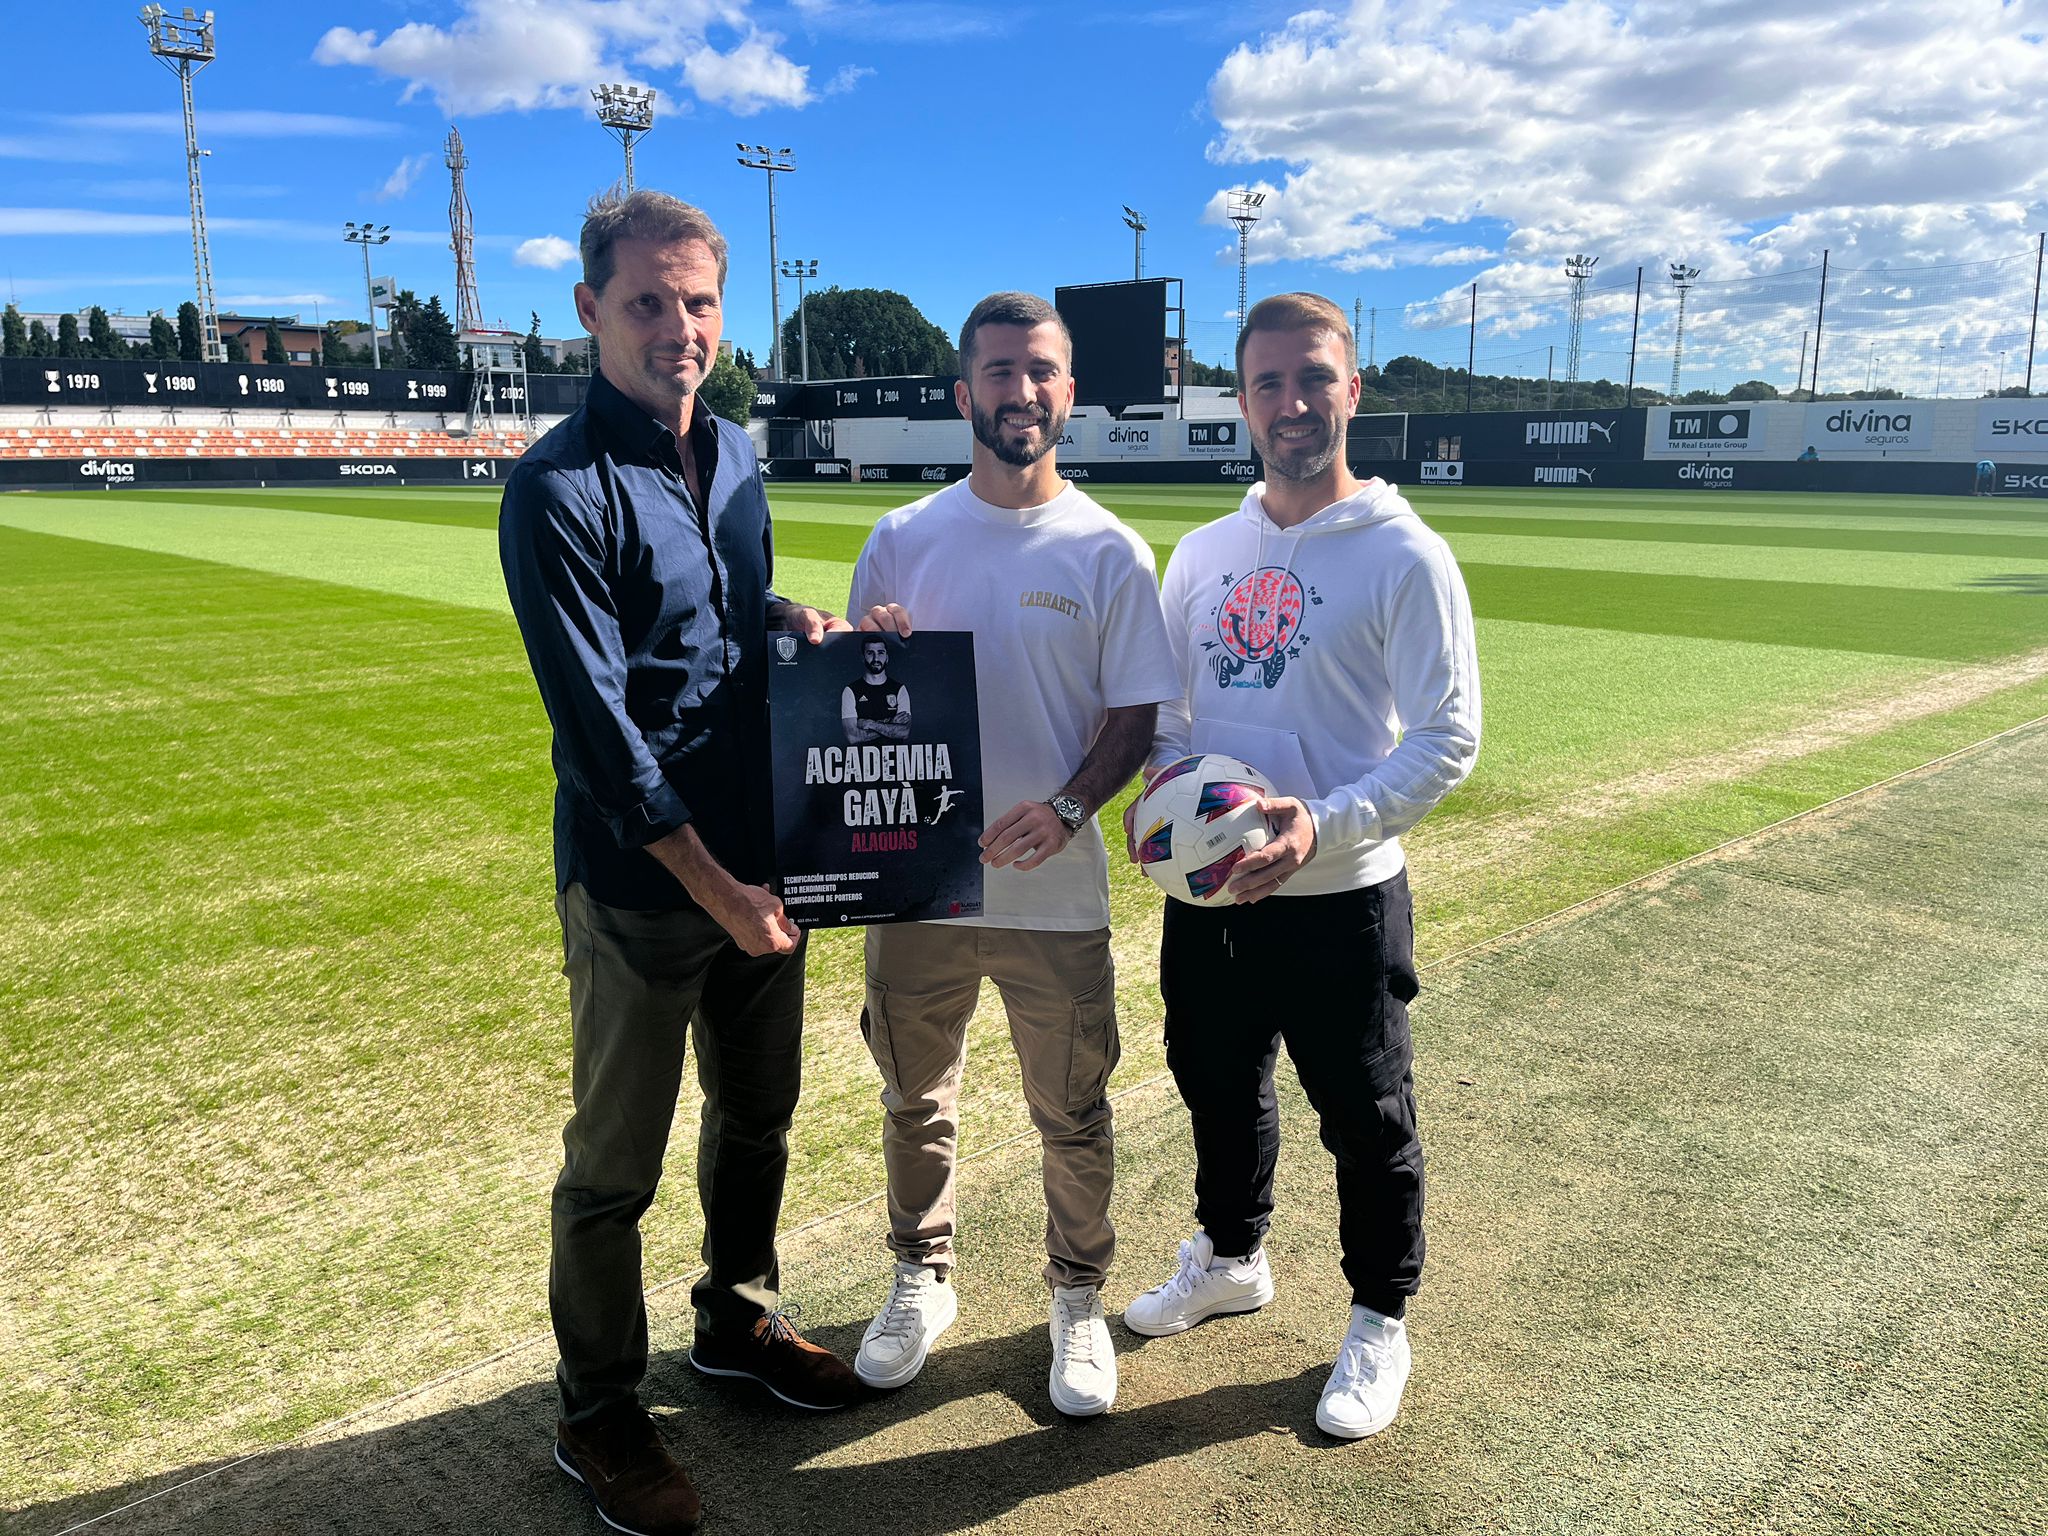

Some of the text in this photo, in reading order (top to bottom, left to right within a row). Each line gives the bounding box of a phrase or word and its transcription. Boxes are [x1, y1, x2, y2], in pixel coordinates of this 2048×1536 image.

[66, 374, 100, 389] 1979
[164, 376, 196, 391] 1980
[255, 377, 285, 393] 1980
[341, 380, 369, 395] 1999
[421, 383, 447, 398] 1999
[500, 387, 524, 399] 2002
[884, 391, 899, 402] 2004
[929, 389, 945, 400] 2008
[757, 394, 776, 405] 2004
[844, 392, 858, 403] 2004
[1675, 418, 1701, 434] TM
[1826, 409, 1912, 433] divina
[1109, 427, 1148, 442] divina
[1191, 429, 1207, 441] TM
[1526, 421, 1589, 445] PUMA
[1724, 442, 1747, 450] Group
[1865, 435, 1909, 446] seguros
[80, 459, 134, 477] divina
[340, 464, 397, 475] SKODA
[815, 463, 840, 474] PUMA
[861, 468, 888, 479] AMSTEL
[921, 466, 947, 480] Coca-Cola
[1221, 462, 1255, 475] divina
[1424, 466, 1437, 475] TM
[1678, 463, 1734, 479] divina
[107, 476, 134, 484] seguros
[1534, 467, 1577, 483] PUMA
[805, 744, 952, 785] ACADEMIA
[843, 782, 918, 827] GAYÀ
[852, 828, 918, 853] ALAQUÀS
[784, 872, 879, 885] TECNIFICACIÓN GRUPOS REDUCIDOS
[784, 884, 837, 895] ALTO RENDIMIENTO
[784, 894, 825, 905] TECNIFICACIÓN
[834, 893, 862, 902] PORTEROS
